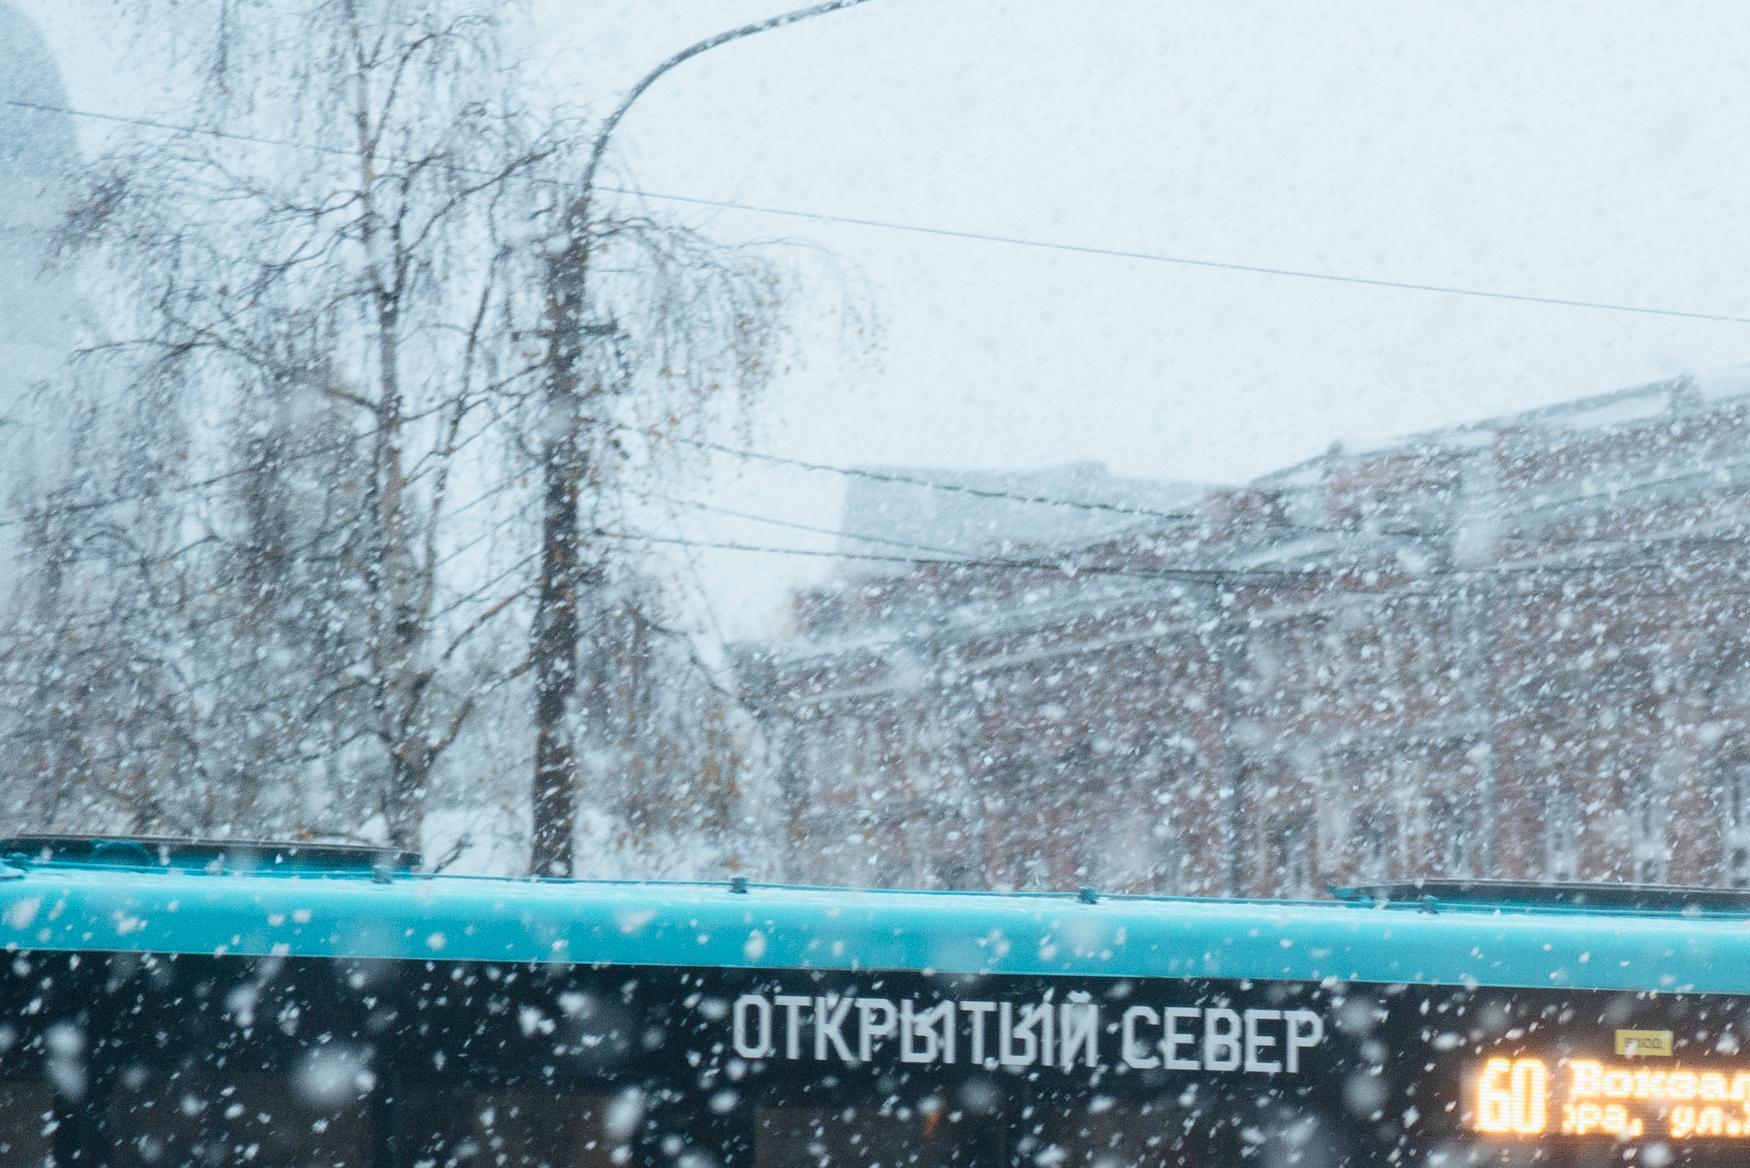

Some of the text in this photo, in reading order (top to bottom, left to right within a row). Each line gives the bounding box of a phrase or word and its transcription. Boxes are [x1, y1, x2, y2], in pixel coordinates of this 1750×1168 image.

[732, 990, 1325, 1073] ОТКРЫТЫЙ СЕВЕР
[1477, 1058, 1548, 1134] 60
